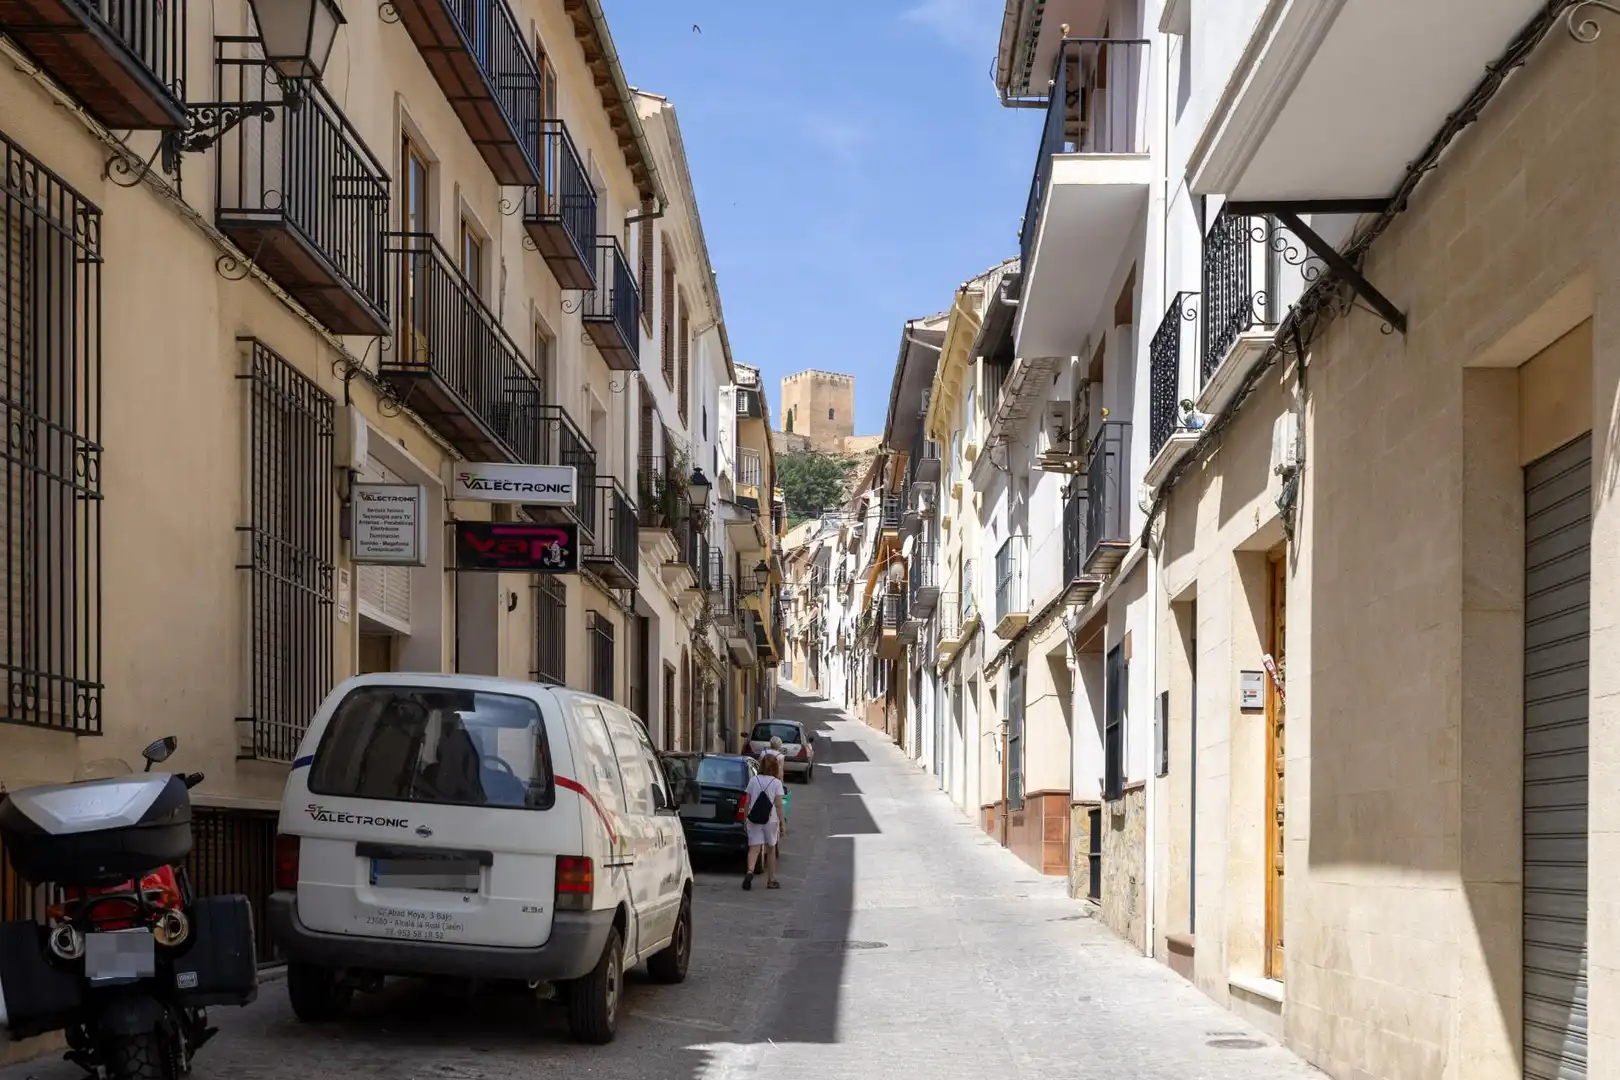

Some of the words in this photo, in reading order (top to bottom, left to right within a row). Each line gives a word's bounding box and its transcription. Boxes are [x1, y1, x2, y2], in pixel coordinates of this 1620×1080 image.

[463, 479, 571, 493] VALECTRONIC
[310, 810, 408, 828] VALECTRONIC
[388, 908, 405, 918] Abad
[407, 910, 427, 920] Moya,
[436, 912, 453, 921] Bajo
[425, 920, 440, 929] Real
[397, 929, 411, 937] 953
[413, 930, 422, 938] 58
[425, 931, 433, 939] 18
[436, 931, 444, 939] 52
